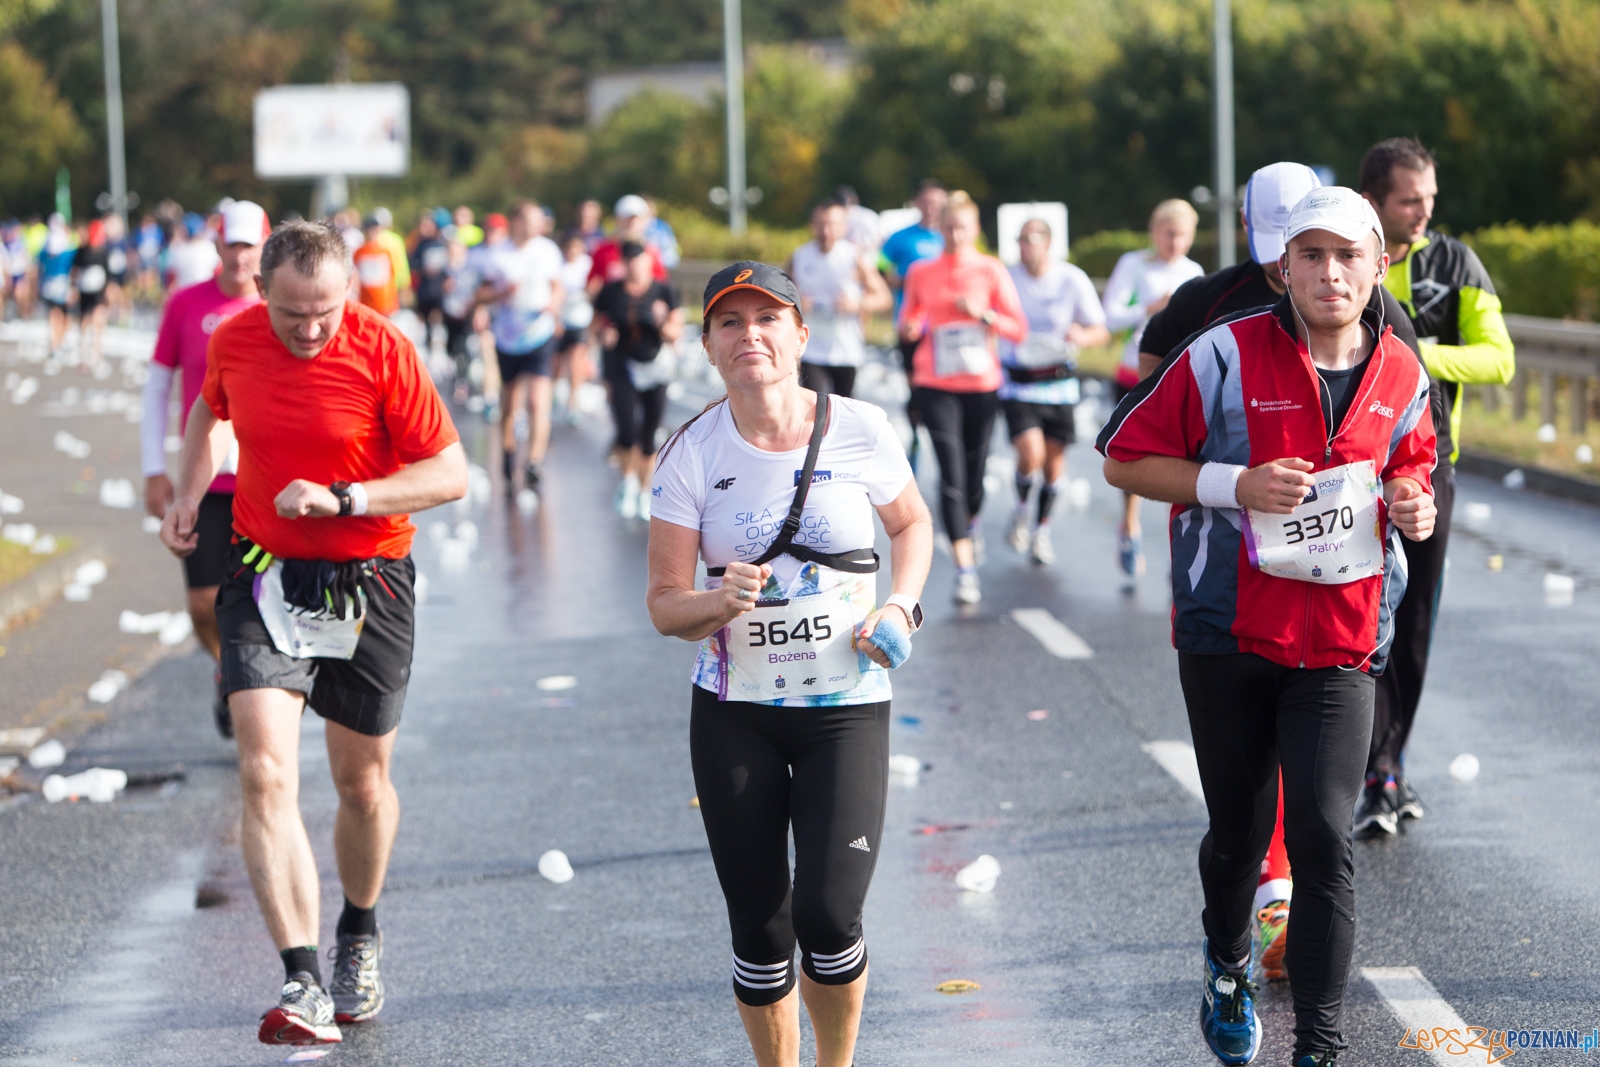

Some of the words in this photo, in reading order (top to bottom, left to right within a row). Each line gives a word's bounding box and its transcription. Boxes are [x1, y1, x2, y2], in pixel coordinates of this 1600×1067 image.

[714, 477, 736, 490] 4F
[734, 508, 772, 525] SIŁA
[1283, 505, 1353, 544] 3370
[1308, 541, 1344, 554] Patryk
[748, 614, 832, 647] 3645
[768, 651, 817, 664] Bożena
[802, 677, 817, 686] 4F
[849, 842, 870, 852] adidas
